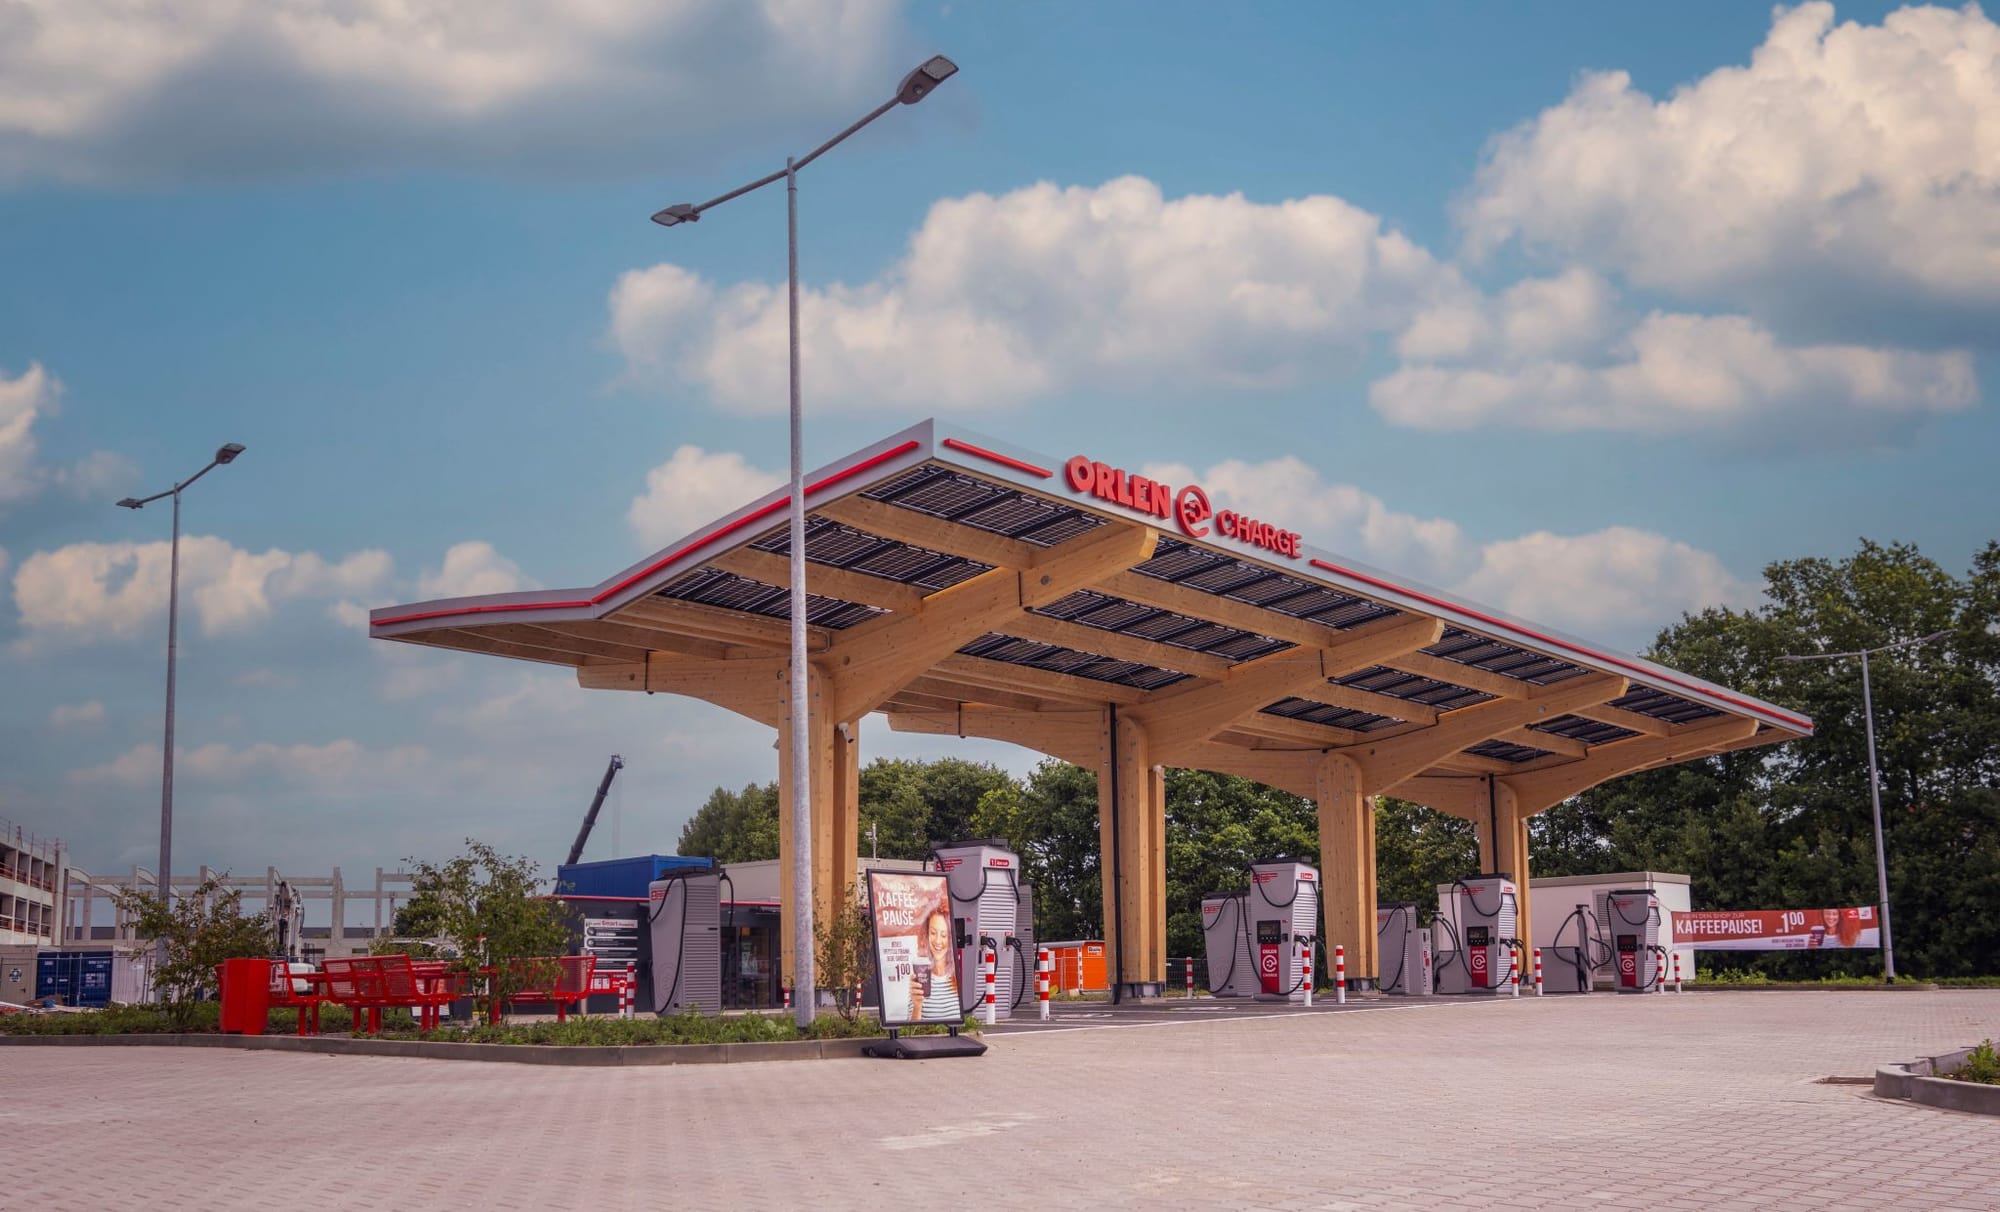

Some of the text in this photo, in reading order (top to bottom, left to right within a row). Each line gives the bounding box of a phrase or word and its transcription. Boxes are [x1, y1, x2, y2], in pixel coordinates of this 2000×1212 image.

[1065, 454, 1171, 519] ORLEN
[1215, 509, 1303, 559] CHARGE
[882, 910, 915, 926] PAUSE
[1676, 919, 1763, 934] KAFFEEPAUSE!
